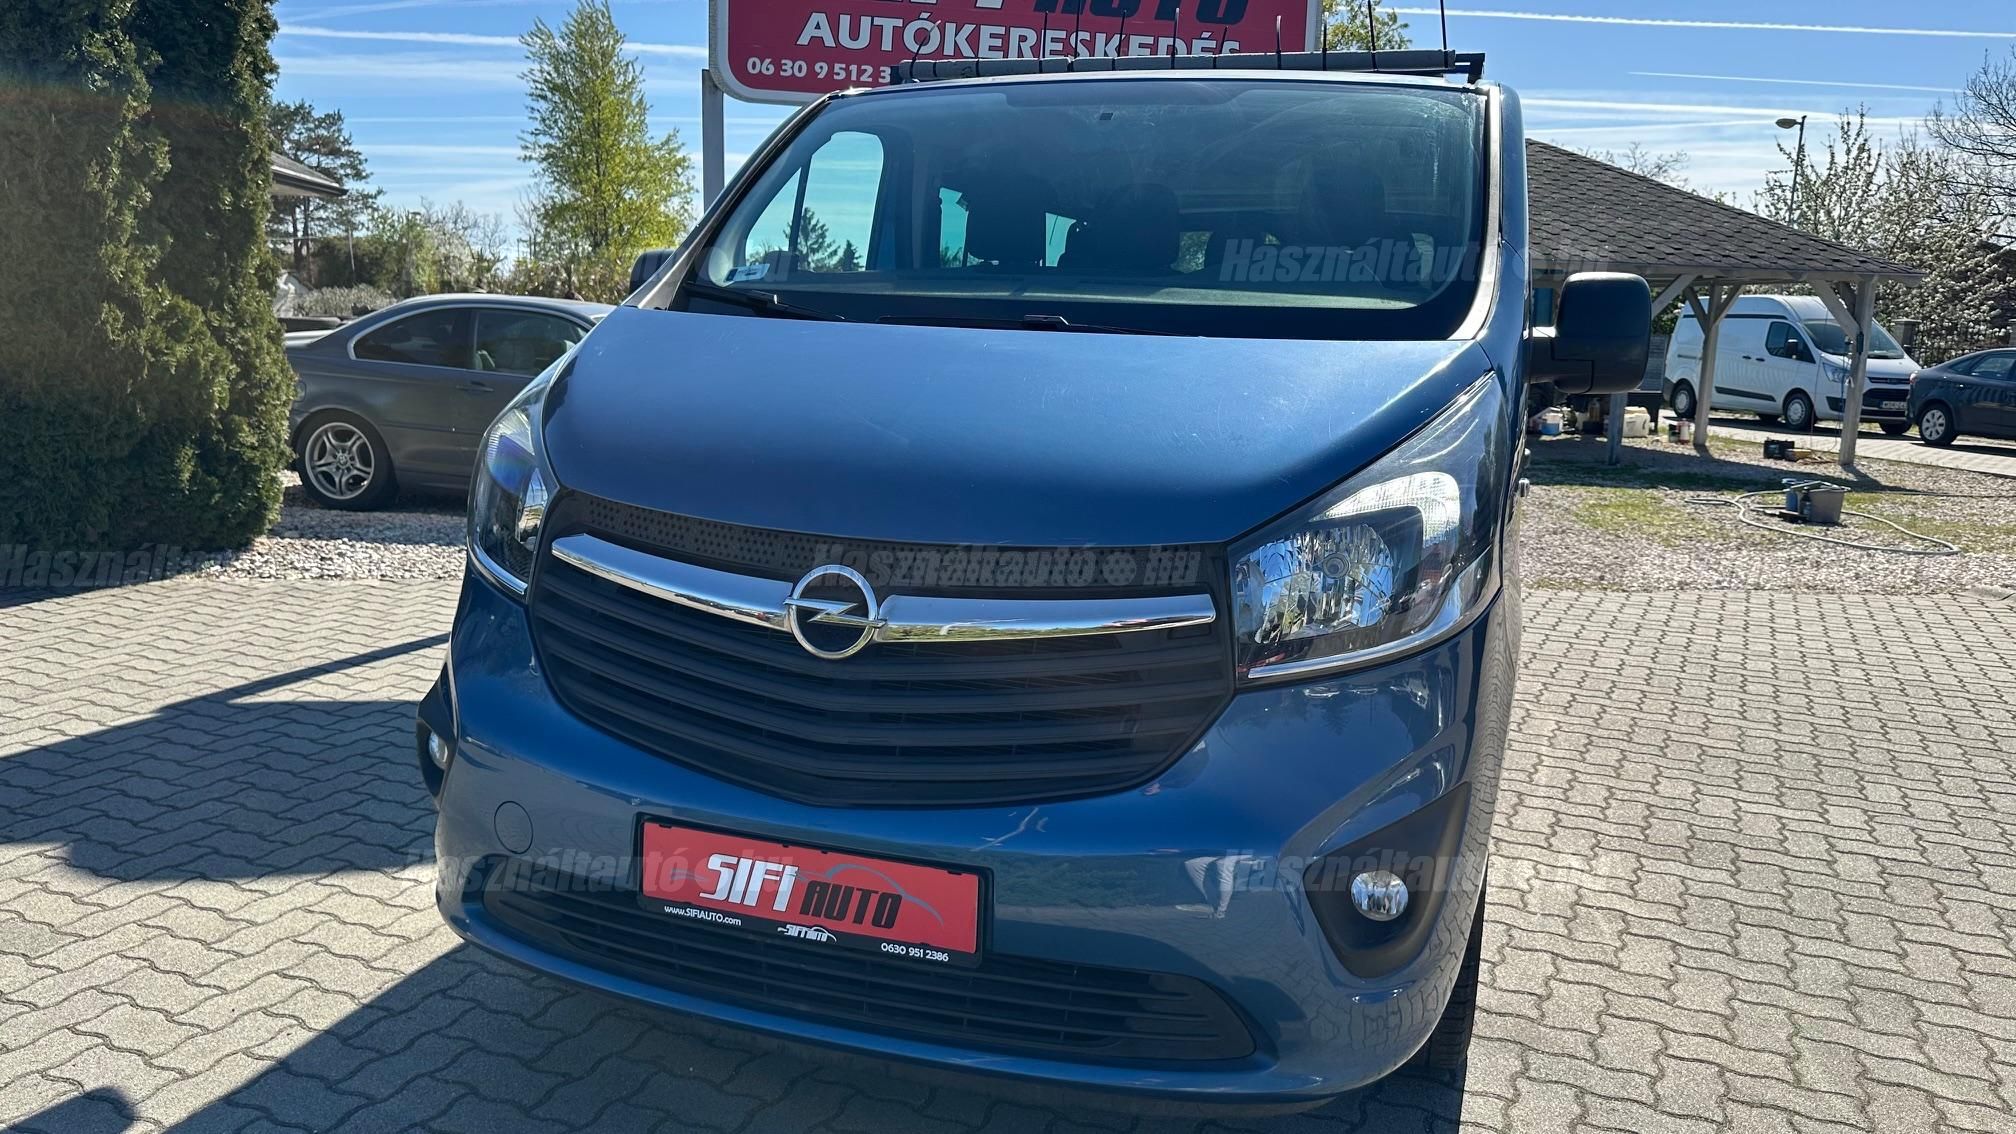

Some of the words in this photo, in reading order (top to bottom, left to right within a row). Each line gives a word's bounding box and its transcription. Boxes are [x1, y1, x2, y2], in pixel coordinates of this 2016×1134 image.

[747, 56, 775, 75] 06
[780, 60, 807, 77] 30
[699, 853, 798, 911] SIFI
[800, 880, 903, 929] AUTO
[664, 905, 742, 926] www.SIFIAUTO.com
[880, 942, 907, 955] 0630
[908, 946, 924, 958] 951
[925, 949, 949, 962] 2386
